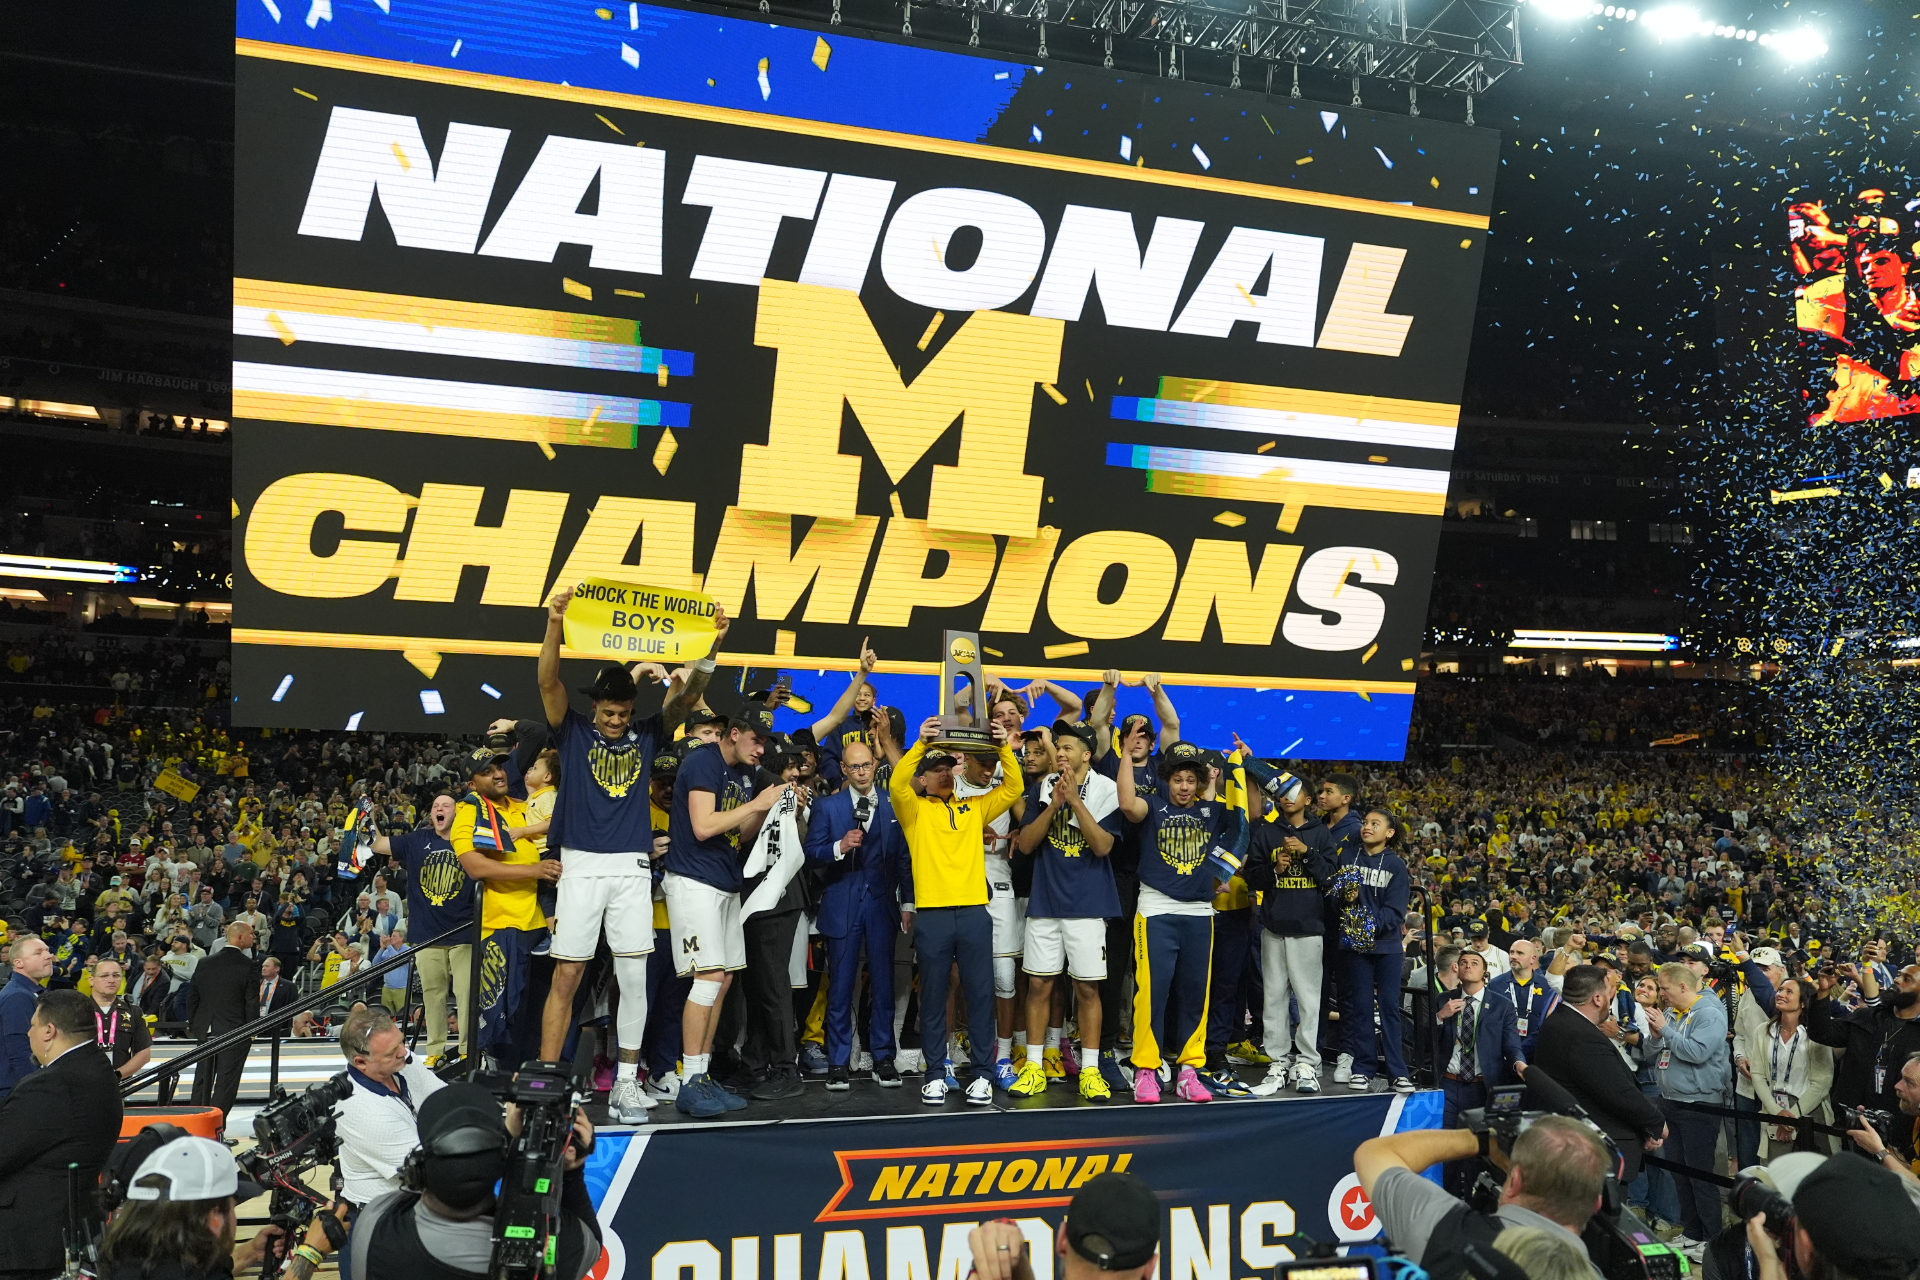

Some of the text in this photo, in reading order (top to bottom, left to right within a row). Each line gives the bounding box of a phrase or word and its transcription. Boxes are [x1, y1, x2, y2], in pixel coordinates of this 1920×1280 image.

[297, 106, 1414, 357] NATIONAL
[98, 370, 122, 383] JIM
[127, 373, 199, 391] HARBAUGH
[738, 277, 1066, 538] M
[1474, 471, 1520, 482] SATURDAY
[244, 472, 1399, 651] CHAMPIONS
[575, 583, 715, 617] SHOCK THE WORLD
[612, 611, 675, 634] BOYS
[602, 633, 623, 650] GO
[628, 636, 665, 654] BLUE
[957, 804, 971, 814] M
[1064, 845, 1080, 857] M
[1158, 827, 1211, 861] CHAMPS
[420, 862, 466, 895] CHAMPS
[1177, 863, 1192, 875] M
[431, 895, 444, 907] M
[682, 935, 700, 954] M
[329, 963, 340, 972] 23
[268, 1150, 293, 1165] RONIN
